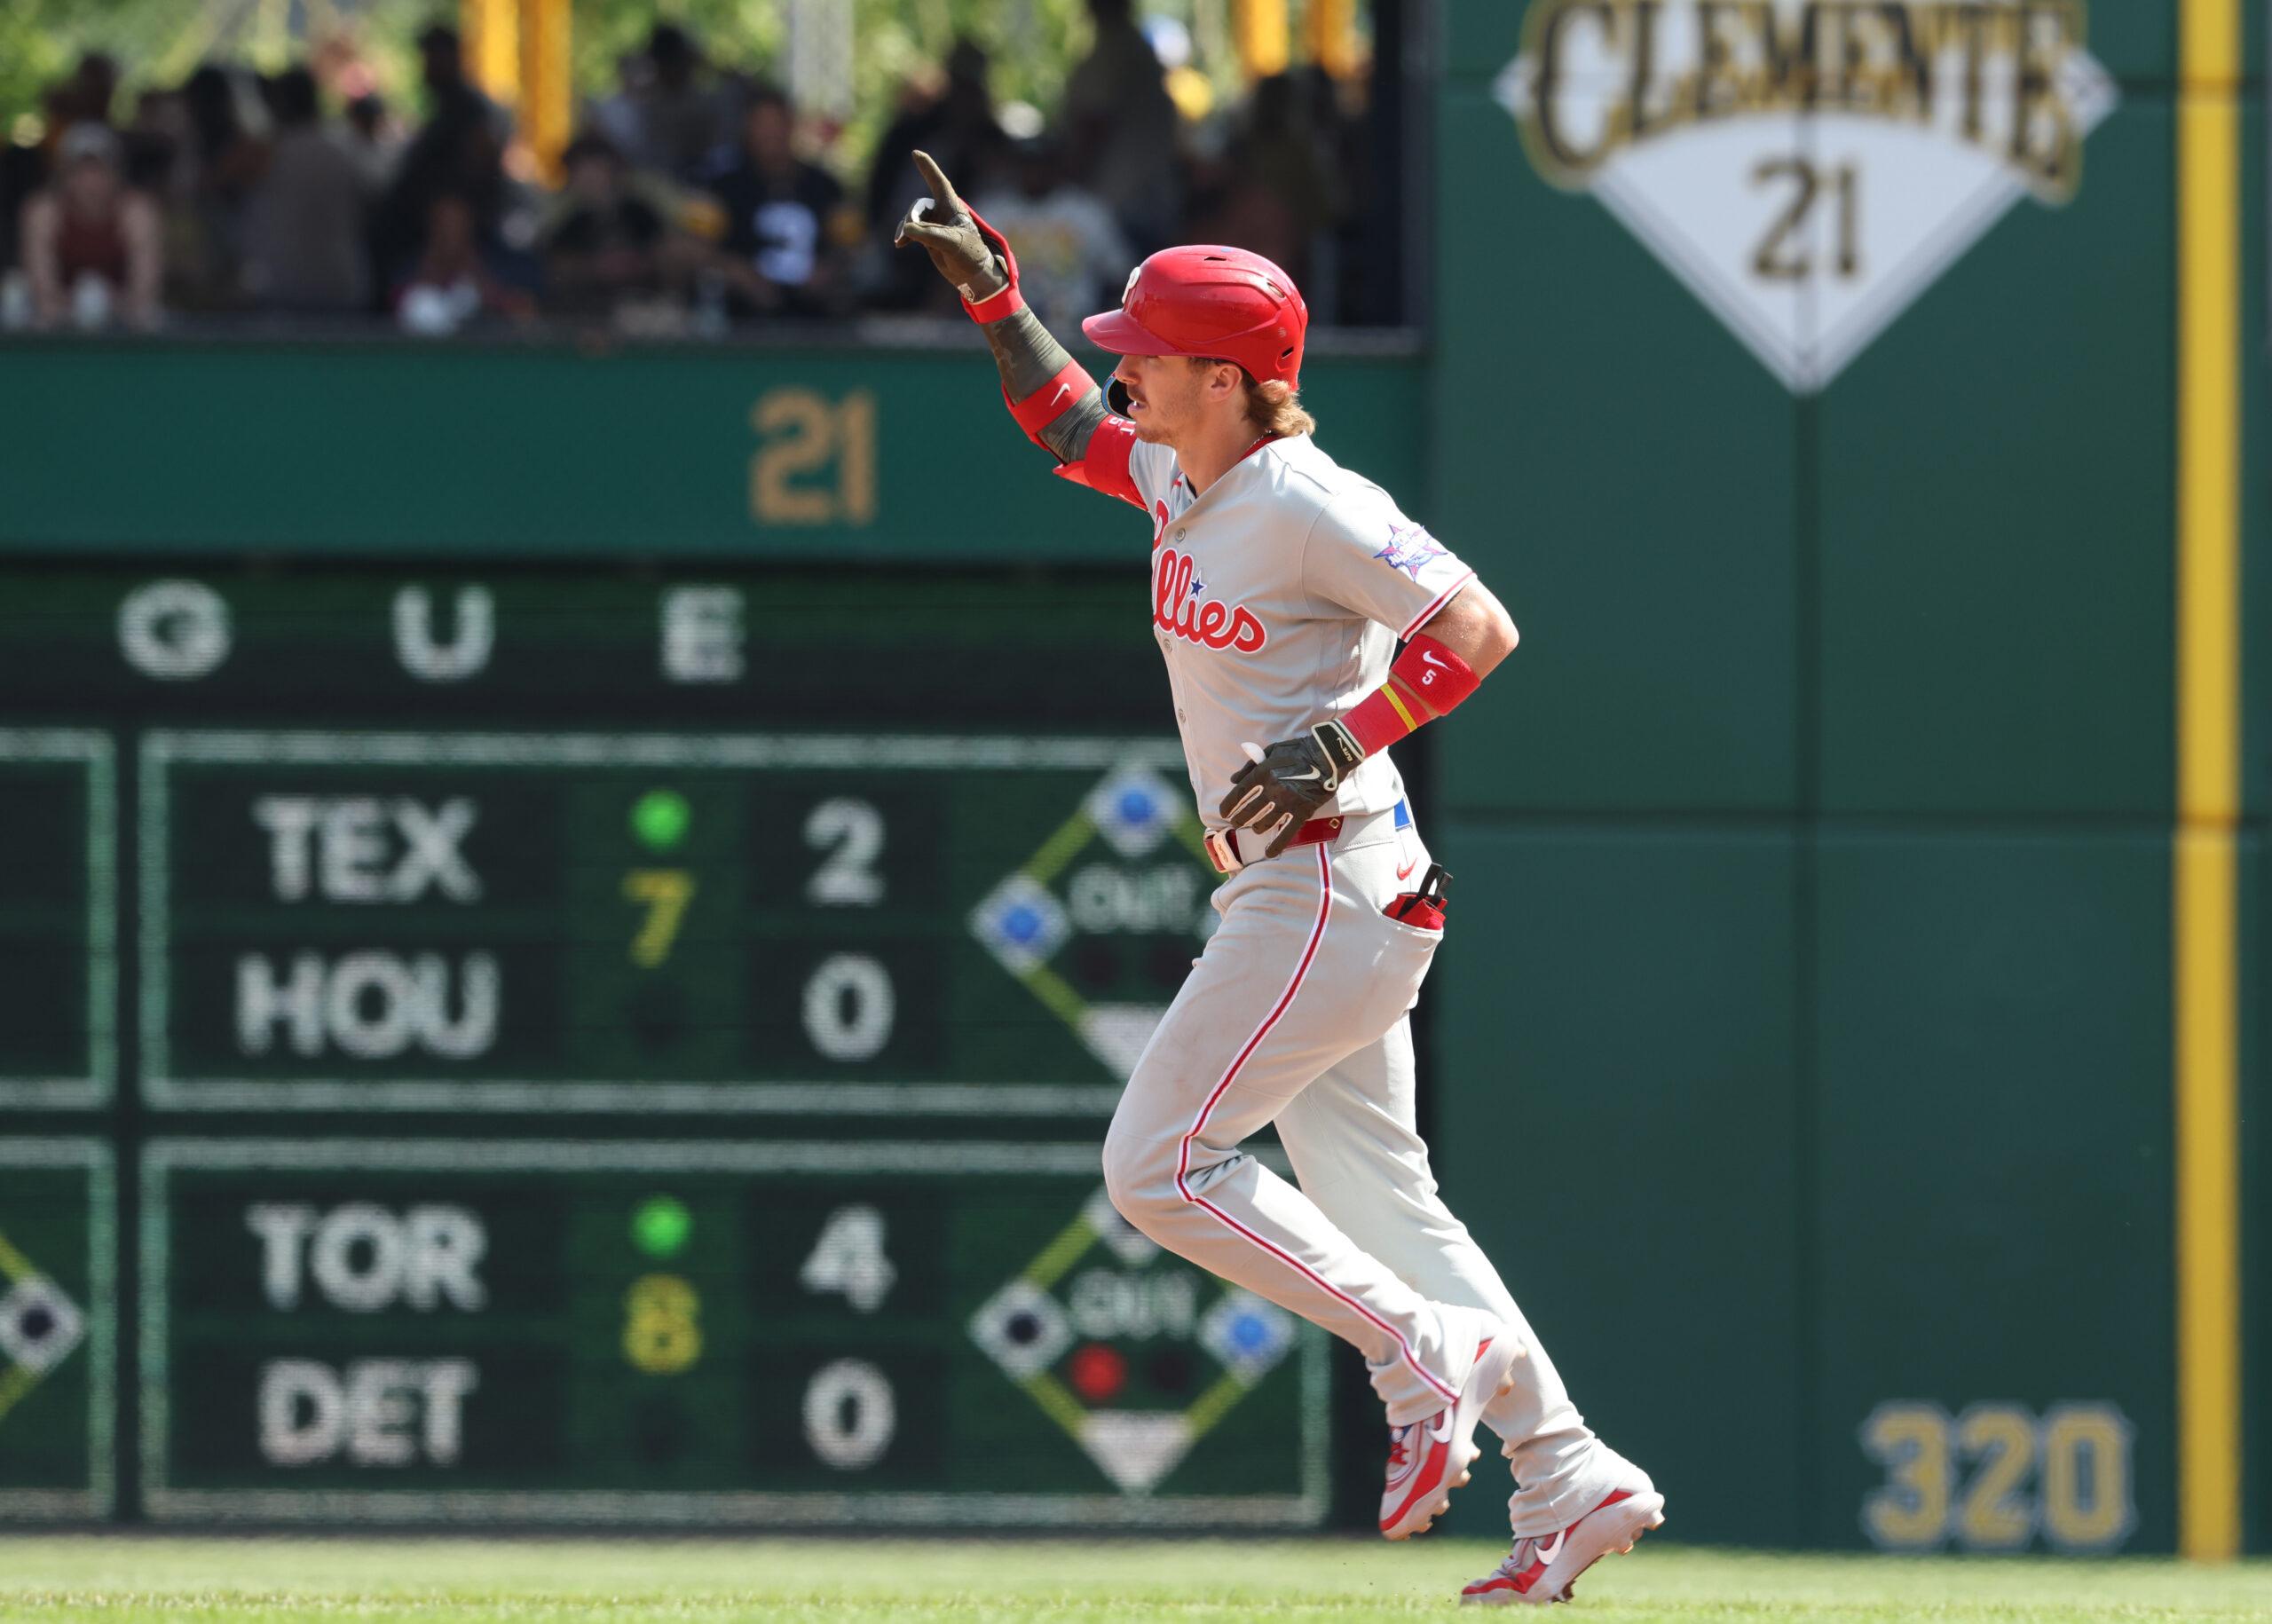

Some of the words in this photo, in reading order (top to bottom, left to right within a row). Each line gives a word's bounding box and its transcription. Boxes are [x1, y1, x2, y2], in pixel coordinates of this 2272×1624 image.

[1519, 0, 2086, 204] CLEMENTE
[1750, 155, 1861, 282] 21
[751, 389, 877, 524] 21
[1422, 668, 1437, 685] 5
[256, 796, 479, 902] TEX
[806, 800, 884, 905] 2
[624, 869, 693, 966] 7
[237, 952, 498, 1058] HOU
[804, 954, 895, 1060] 0
[248, 1202, 486, 1311] TOR
[801, 1206, 895, 1311] 4
[623, 1274, 702, 1374] 8
[259, 1360, 477, 1465] DET
[803, 1360, 895, 1467] 0
[1862, 1404, 2135, 1551] 320
